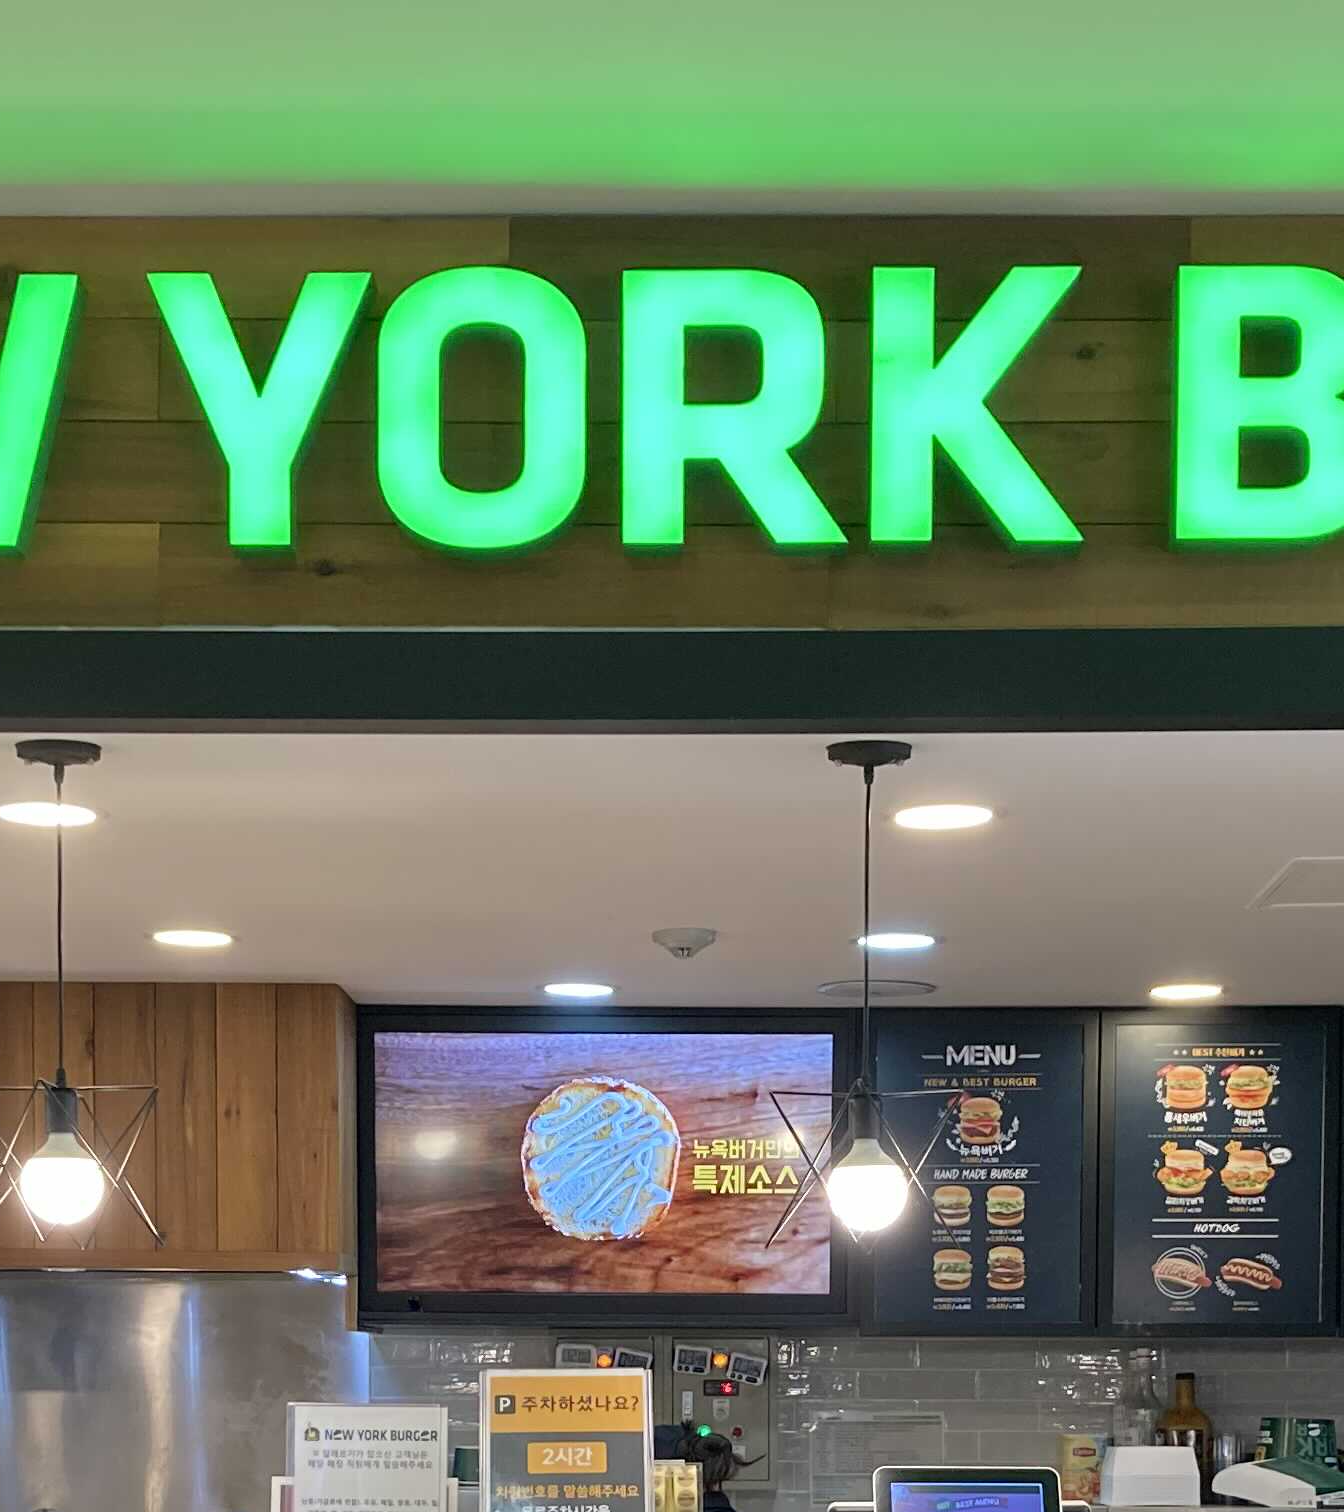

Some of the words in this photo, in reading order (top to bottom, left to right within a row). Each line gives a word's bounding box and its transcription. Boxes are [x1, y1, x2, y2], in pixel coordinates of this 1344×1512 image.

[146, 265, 1084, 551] YORK
[945, 1045, 1016, 1066] MENU
[962, 1076, 990, 1087] BEST
[992, 1076, 1037, 1087] BURGER
[692, 1164, 799, 1195] 특제소스
[933, 1168, 960, 1180] HAND
[961, 1168, 988, 1180] MADE
[989, 1167, 1028, 1180] BURGER
[1193, 1223, 1241, 1234] HOTDOG
[498, 1396, 512, 1413] P
[521, 1394, 640, 1413] 주차하셨나요?
[357, 1429, 388, 1441] YORK
[390, 1429, 439, 1442] BURGER
[541, 1446, 593, 1468] 2시간
[563, 1483, 640, 1499] 말씀해주세요
